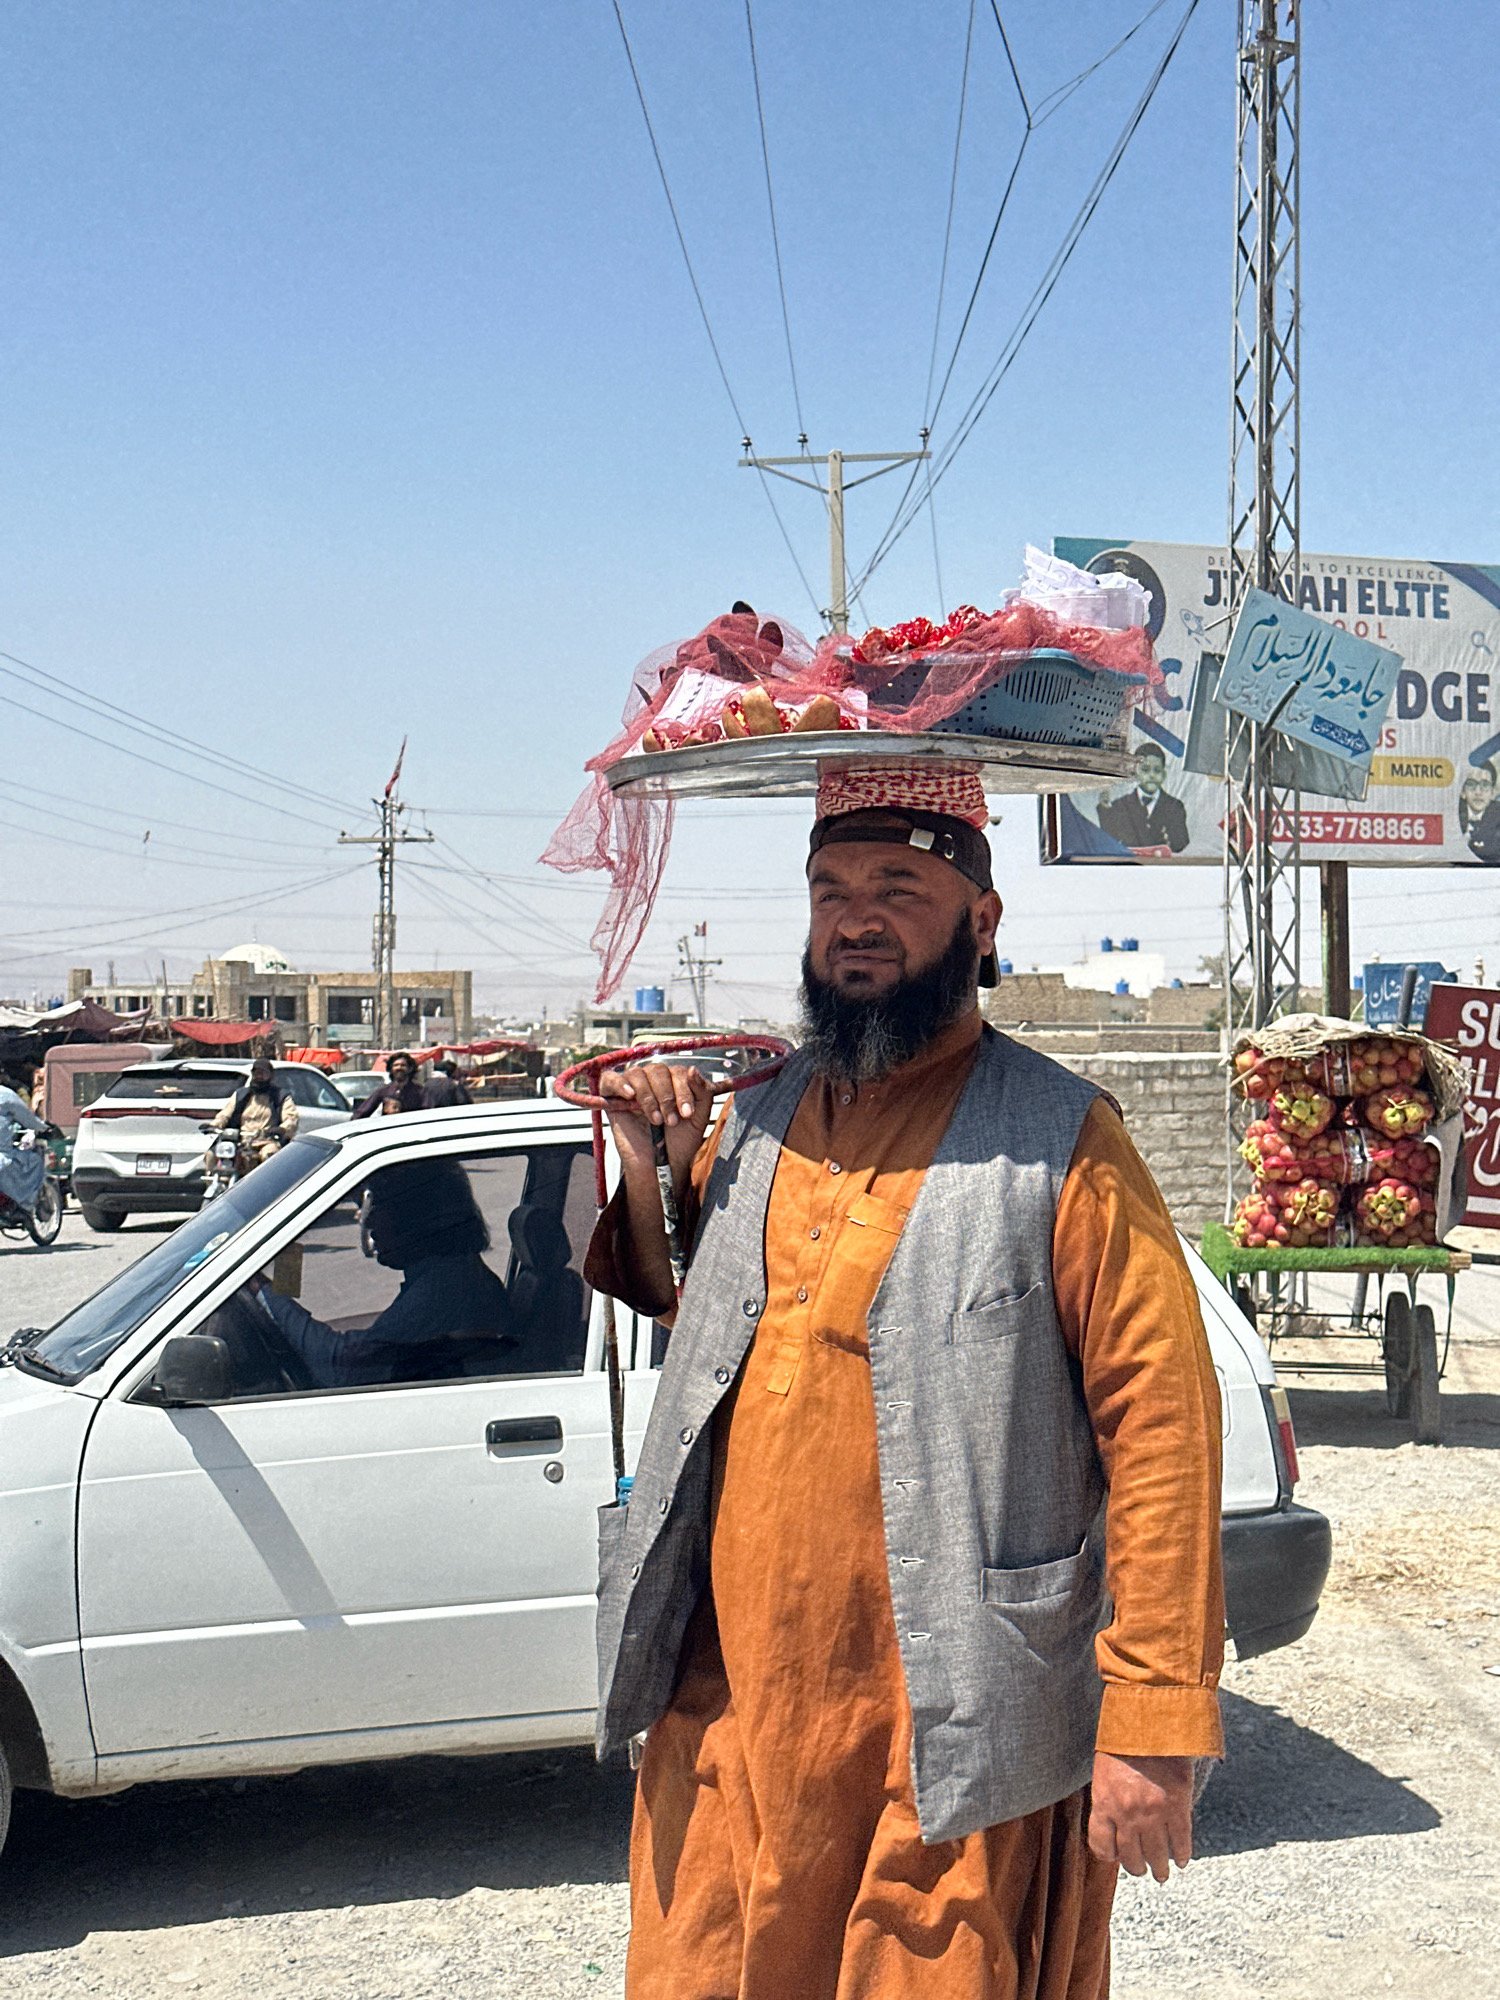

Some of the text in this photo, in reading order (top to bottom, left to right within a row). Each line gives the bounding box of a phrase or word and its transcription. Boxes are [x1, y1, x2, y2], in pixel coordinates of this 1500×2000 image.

[1319, 563, 1338, 574] TO
[1347, 565, 1444, 581] EXCELLENCE
[1358, 579, 1449, 620] ELITE
[1391, 763, 1443, 779] MATRIC
